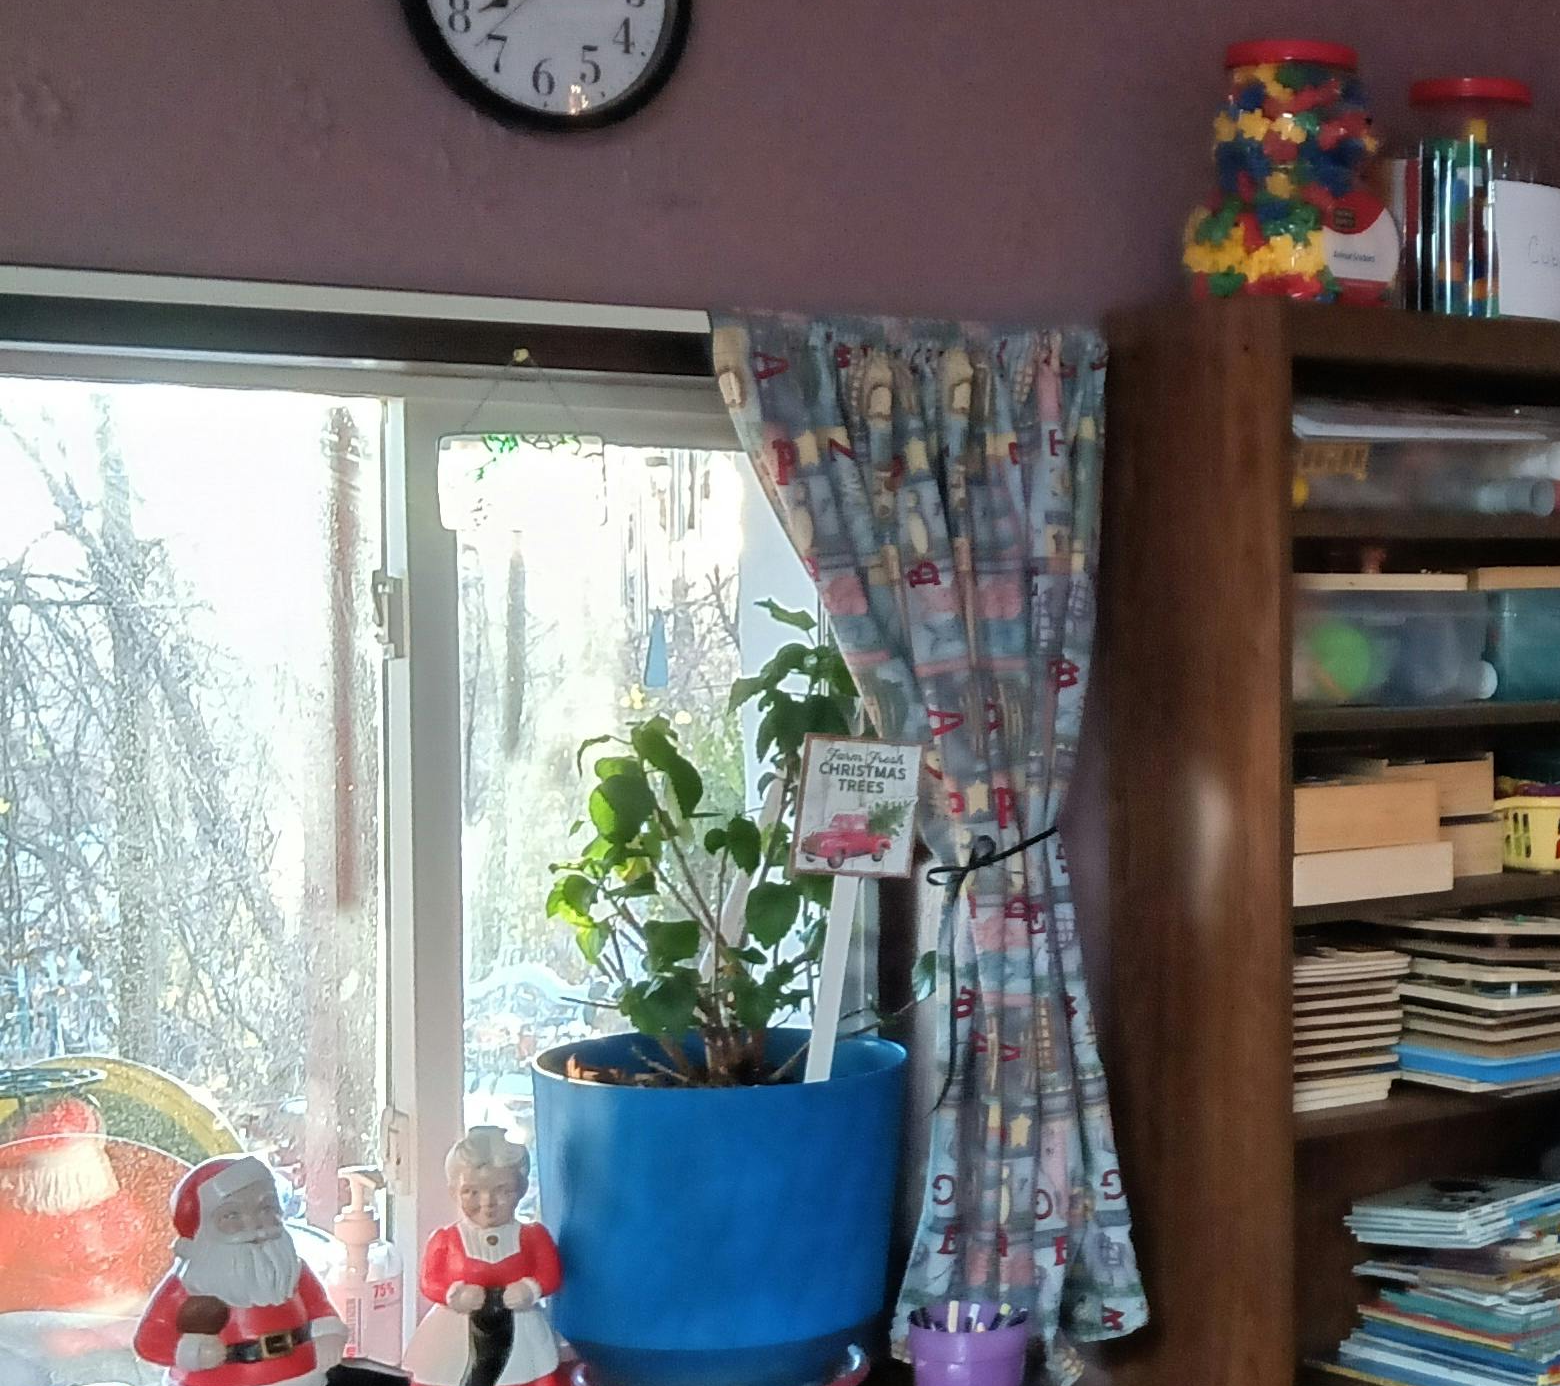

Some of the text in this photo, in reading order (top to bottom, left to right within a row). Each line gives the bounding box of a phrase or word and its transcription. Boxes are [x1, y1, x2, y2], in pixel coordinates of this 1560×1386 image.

[612, 17, 636, 54] 4
[486, 33, 507, 73] 7
[580, 45, 601, 84] 5
[532, 58, 555, 96] 6
[827, 748, 904, 765] Farm Fresh
[819, 762, 906, 780] CHRISTMAS
[838, 778, 885, 794] TREES
[373, 1281, 395, 1299] 75%
